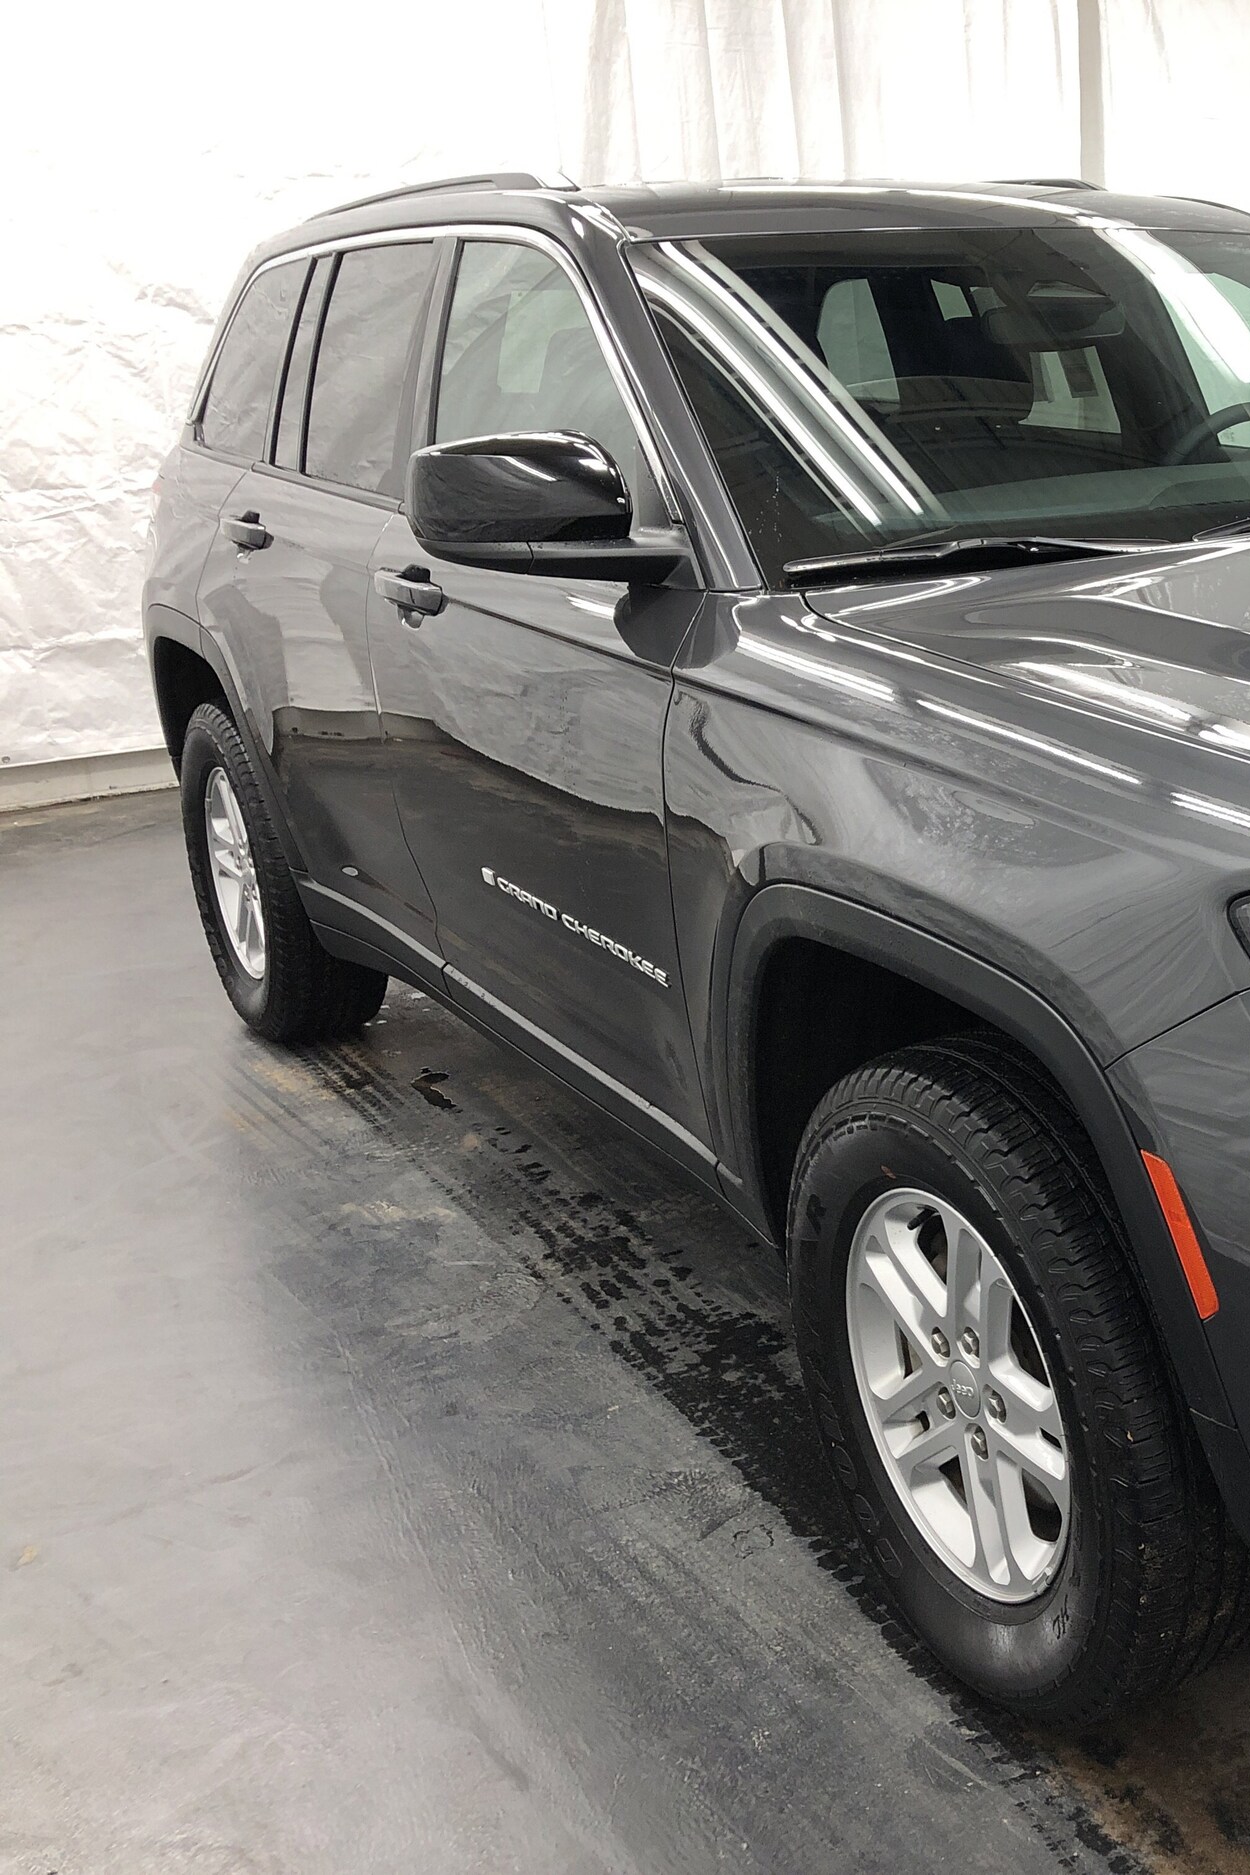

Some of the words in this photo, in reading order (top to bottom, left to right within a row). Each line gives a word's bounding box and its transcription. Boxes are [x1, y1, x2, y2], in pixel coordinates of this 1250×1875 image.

[497, 877, 559, 921] GRAND
[561, 913, 671, 988] CHEROKEE
[951, 1378, 974, 1397] Jeep
